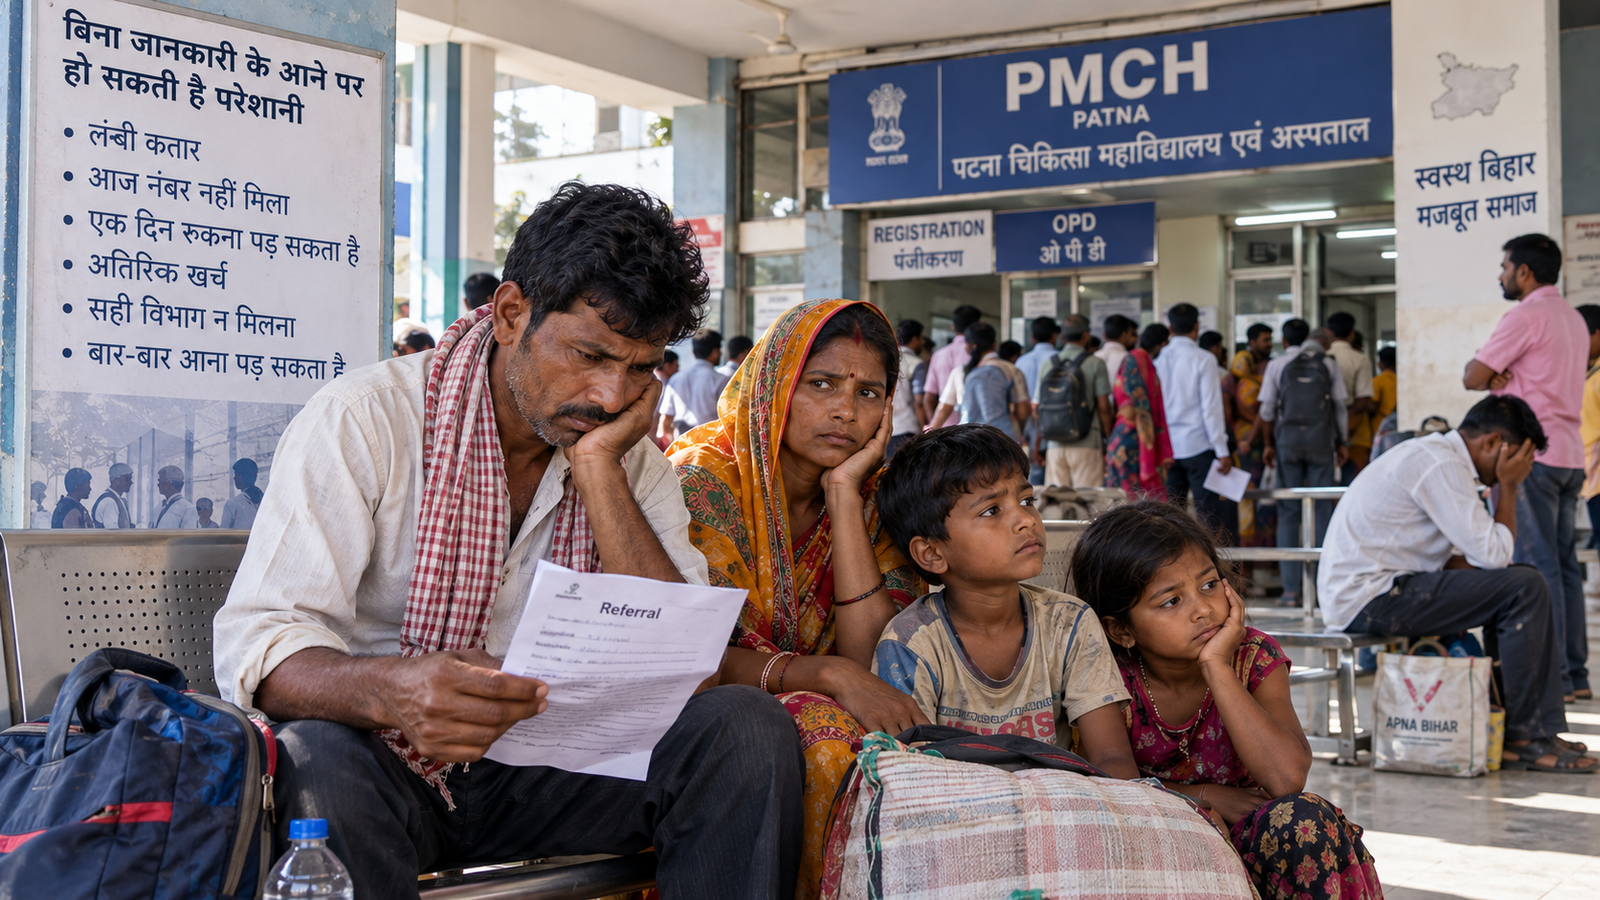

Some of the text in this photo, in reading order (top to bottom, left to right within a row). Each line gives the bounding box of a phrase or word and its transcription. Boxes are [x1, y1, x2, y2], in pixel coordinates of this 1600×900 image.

[63, 9, 364, 98] बिना जानकारी के आने पर
[63, 52, 305, 124] हो सकती है परेशानी
[1006, 41, 1209, 112] PMCH
[1073, 104, 1151, 130] PATNA
[145, 133, 201, 161] कतार
[952, 117, 1371, 180] पटना चिकित्सा महाविद्यालय एवं अस्पताल
[1414, 149, 1537, 190] स्वस्थ बिहार
[89, 168, 290, 215] आज नंबर नहीं मिला
[1052, 212, 1096, 234] OPD
[1416, 191, 1538, 232] मजबूत समाज
[88, 211, 127, 237] एक
[135, 208, 174, 242] दिन
[250, 231, 279, 259] पड़
[285, 236, 341, 261] सकता
[347, 234, 360, 267] है
[873, 220, 985, 243] REGISTRATION
[1039, 236, 1106, 264] ओ पी डी
[186, 260, 229, 290] खर्च
[893, 246, 964, 270] पंजीकरण
[88, 293, 296, 338] सही विभाग न मिलना
[88, 343, 172, 370] बार-बार
[180, 349, 229, 373] आना
[235, 354, 264, 381] पड़
[270, 357, 327, 380] सकता
[599, 601, 662, 620] Referral
[1385, 716, 1459, 734] APNA BIHAR
